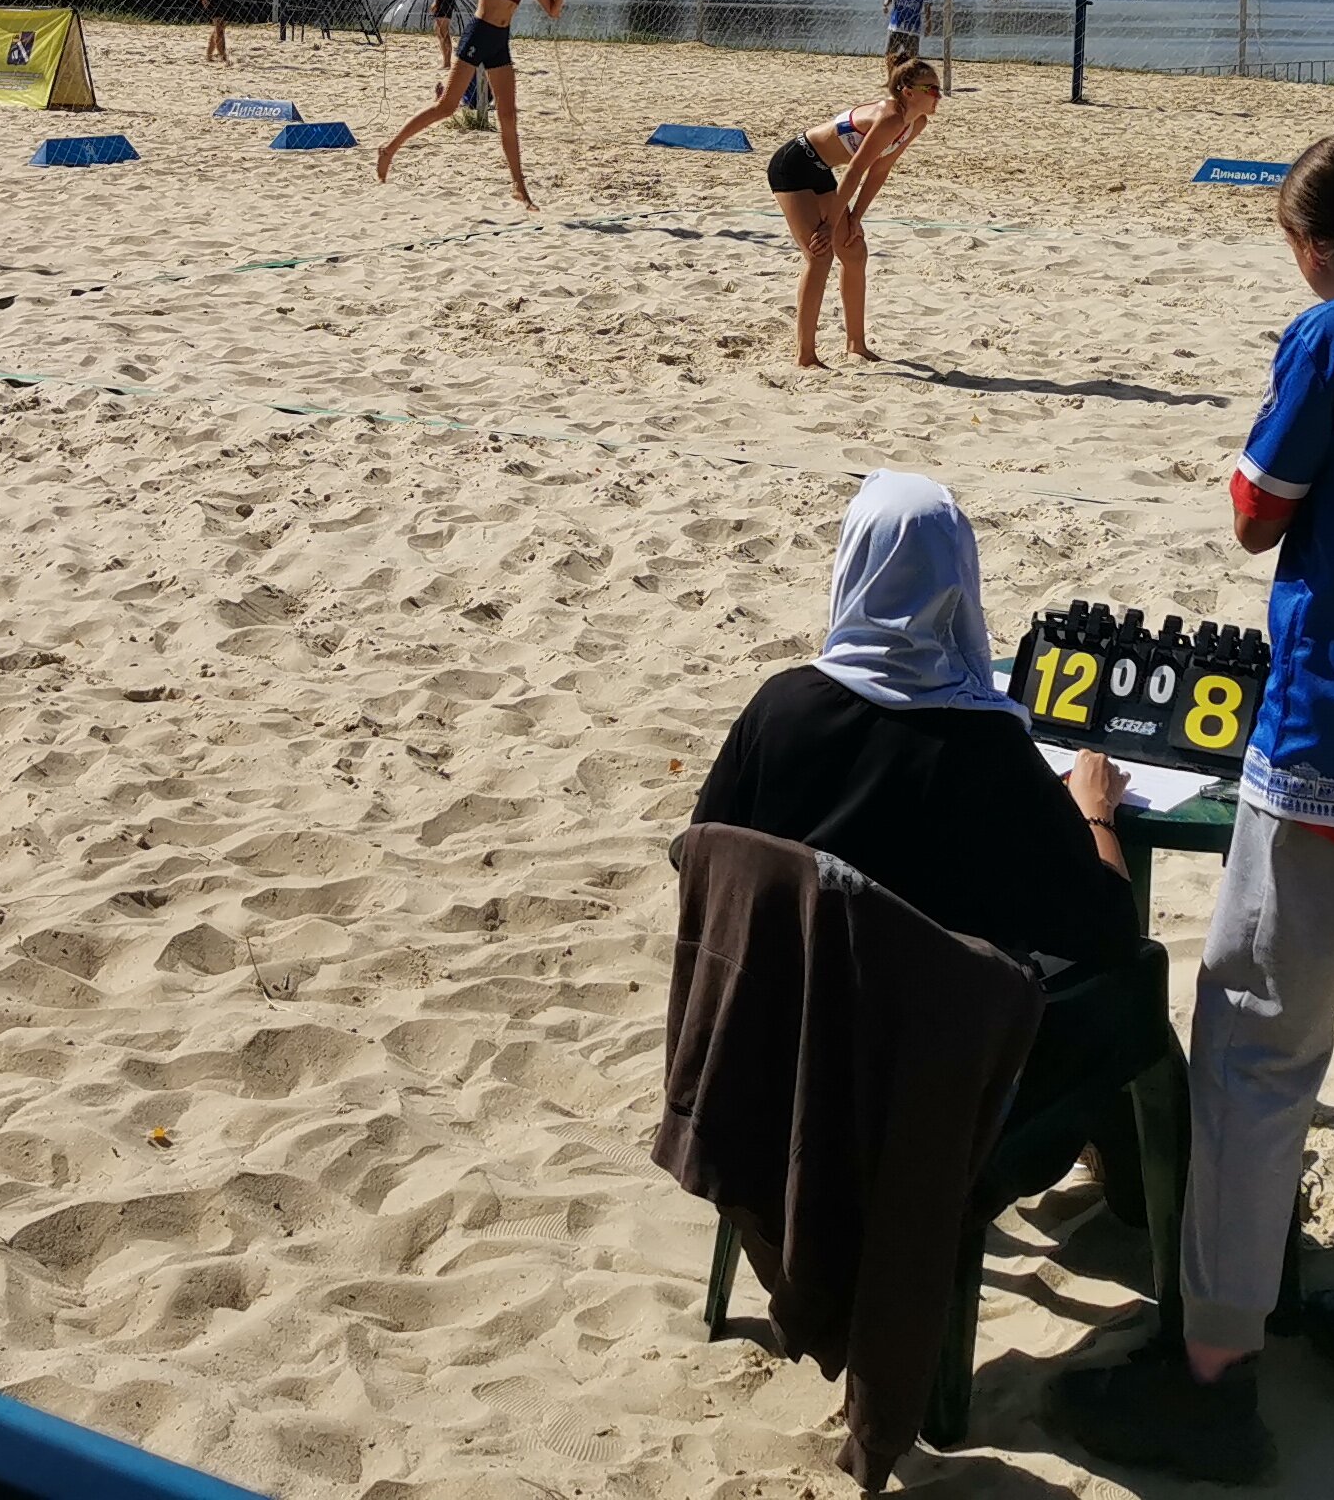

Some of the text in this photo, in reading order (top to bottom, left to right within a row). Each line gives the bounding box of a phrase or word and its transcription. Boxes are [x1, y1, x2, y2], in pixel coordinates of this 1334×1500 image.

[227, 101, 282, 118] Динамо
[1210, 167, 1286, 183] Динамо Ряз
[1033, 647, 1243, 749] 12 0 0 8
